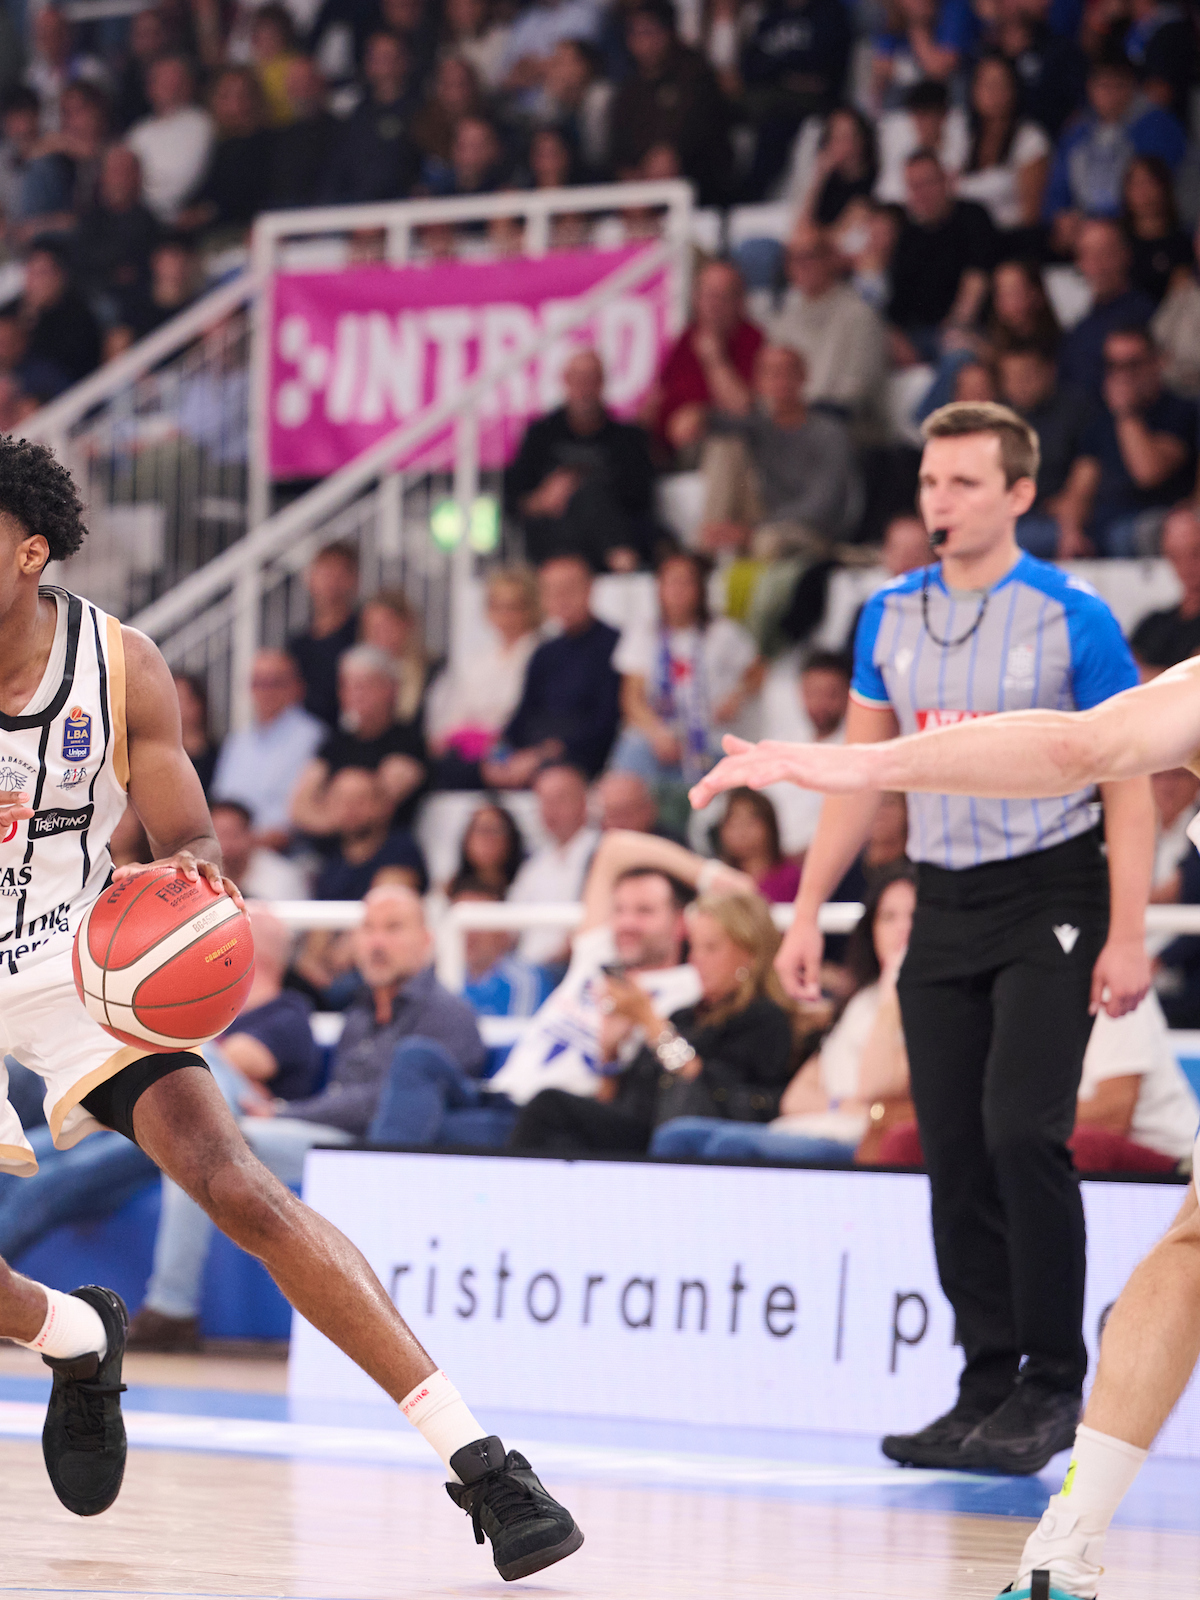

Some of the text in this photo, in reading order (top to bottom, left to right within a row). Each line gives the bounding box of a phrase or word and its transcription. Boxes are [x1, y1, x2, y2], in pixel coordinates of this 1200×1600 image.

[66, 729, 89, 740] LBA
[68, 747, 88, 758] Unipol
[8, 756, 37, 774] BASKET
[34, 812, 88, 832] TRENTINO
[154, 878, 192, 903] FIBA
[390, 1236, 797, 1340] ristorante
